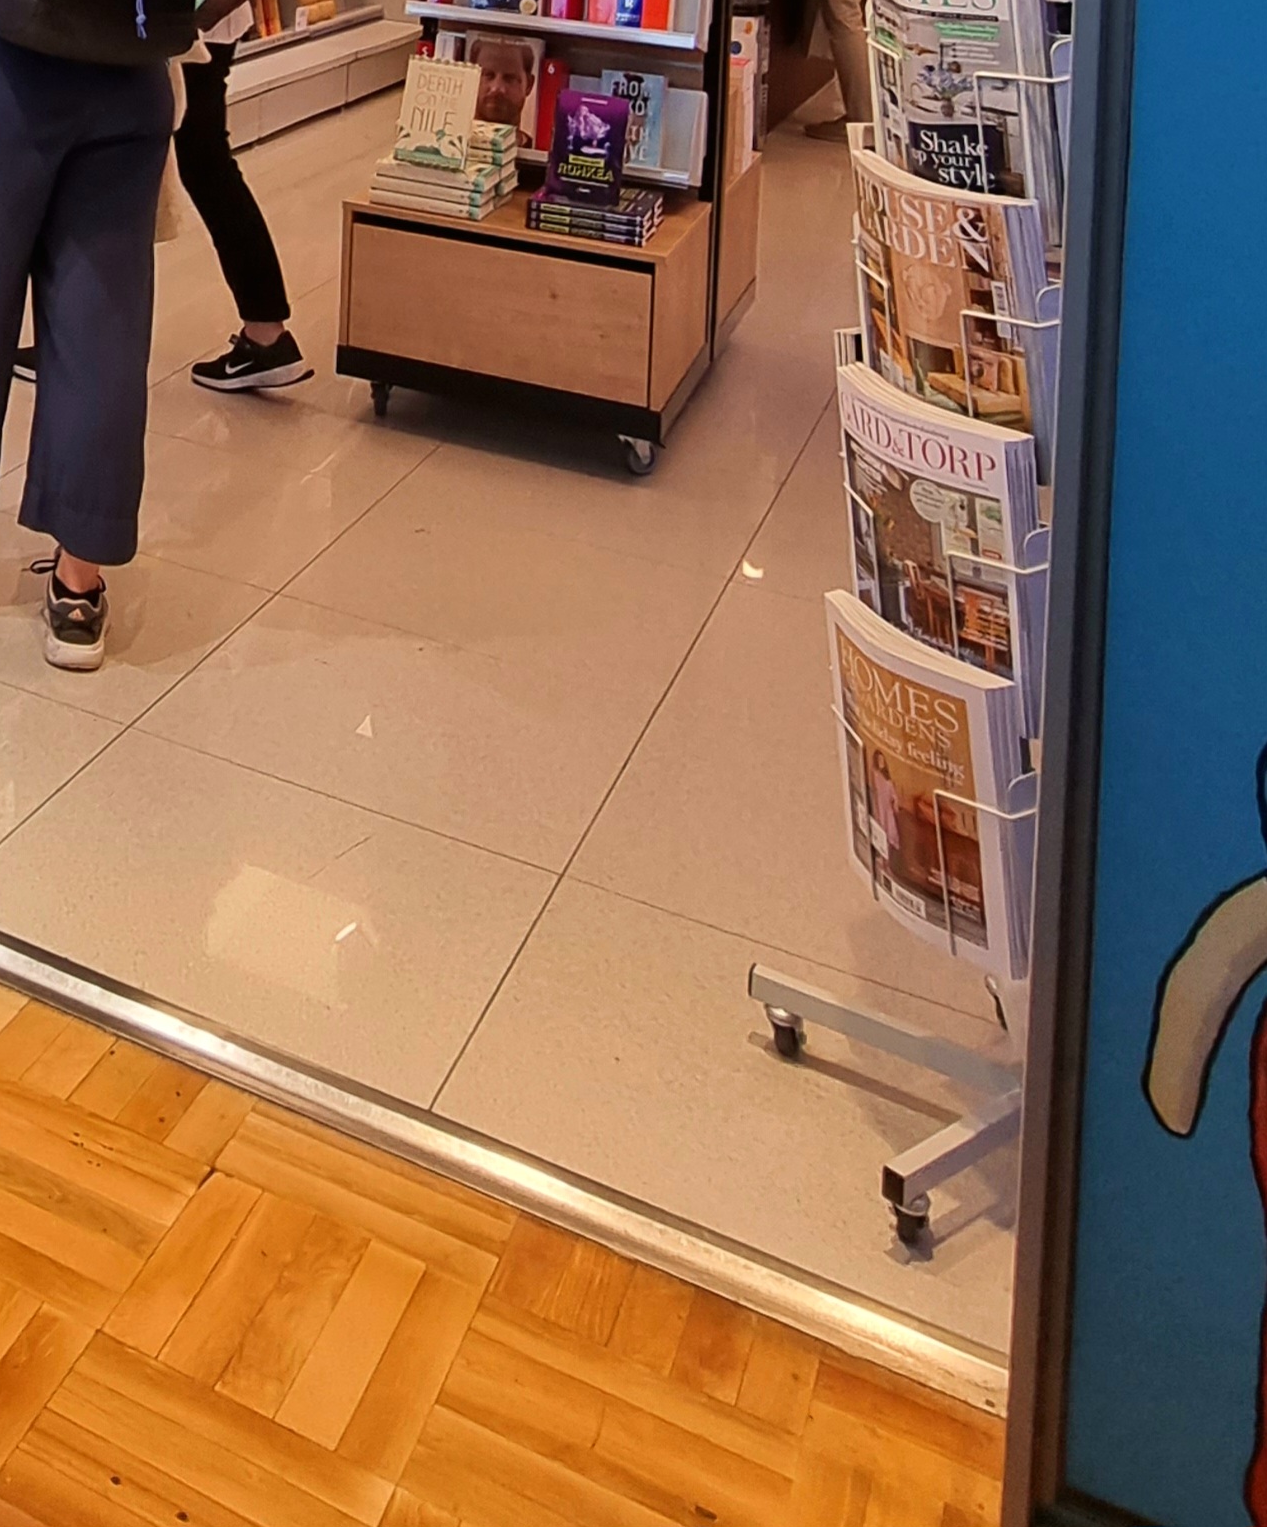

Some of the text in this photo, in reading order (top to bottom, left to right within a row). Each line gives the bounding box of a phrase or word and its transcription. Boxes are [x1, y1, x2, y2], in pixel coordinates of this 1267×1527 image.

[547, 62, 555, 75] 6
[416, 73, 464, 95] DEATH
[410, 106, 457, 137] NILE
[920, 129, 989, 156] Shake
[932, 151, 973, 169] your
[938, 164, 996, 191] style
[854, 165, 989, 242] HOUSE &
[860, 198, 994, 273] GARDEN
[839, 634, 959, 733] HOMES
